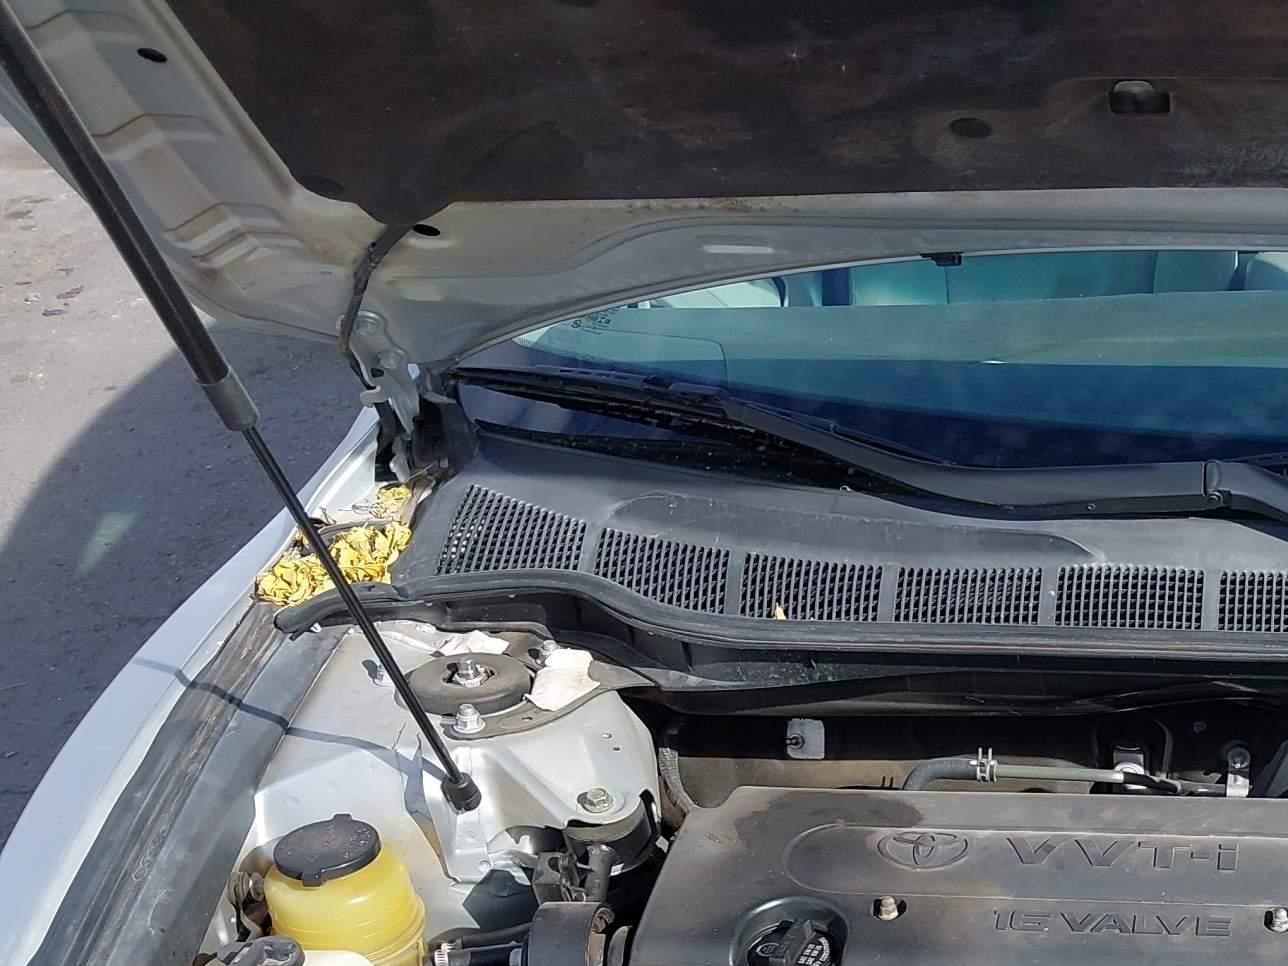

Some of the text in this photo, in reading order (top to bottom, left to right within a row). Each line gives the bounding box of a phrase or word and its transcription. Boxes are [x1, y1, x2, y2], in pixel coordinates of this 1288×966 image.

[1006, 837, 1240, 871] VVT-i
[993, 909, 1233, 936] 16 VALVE
